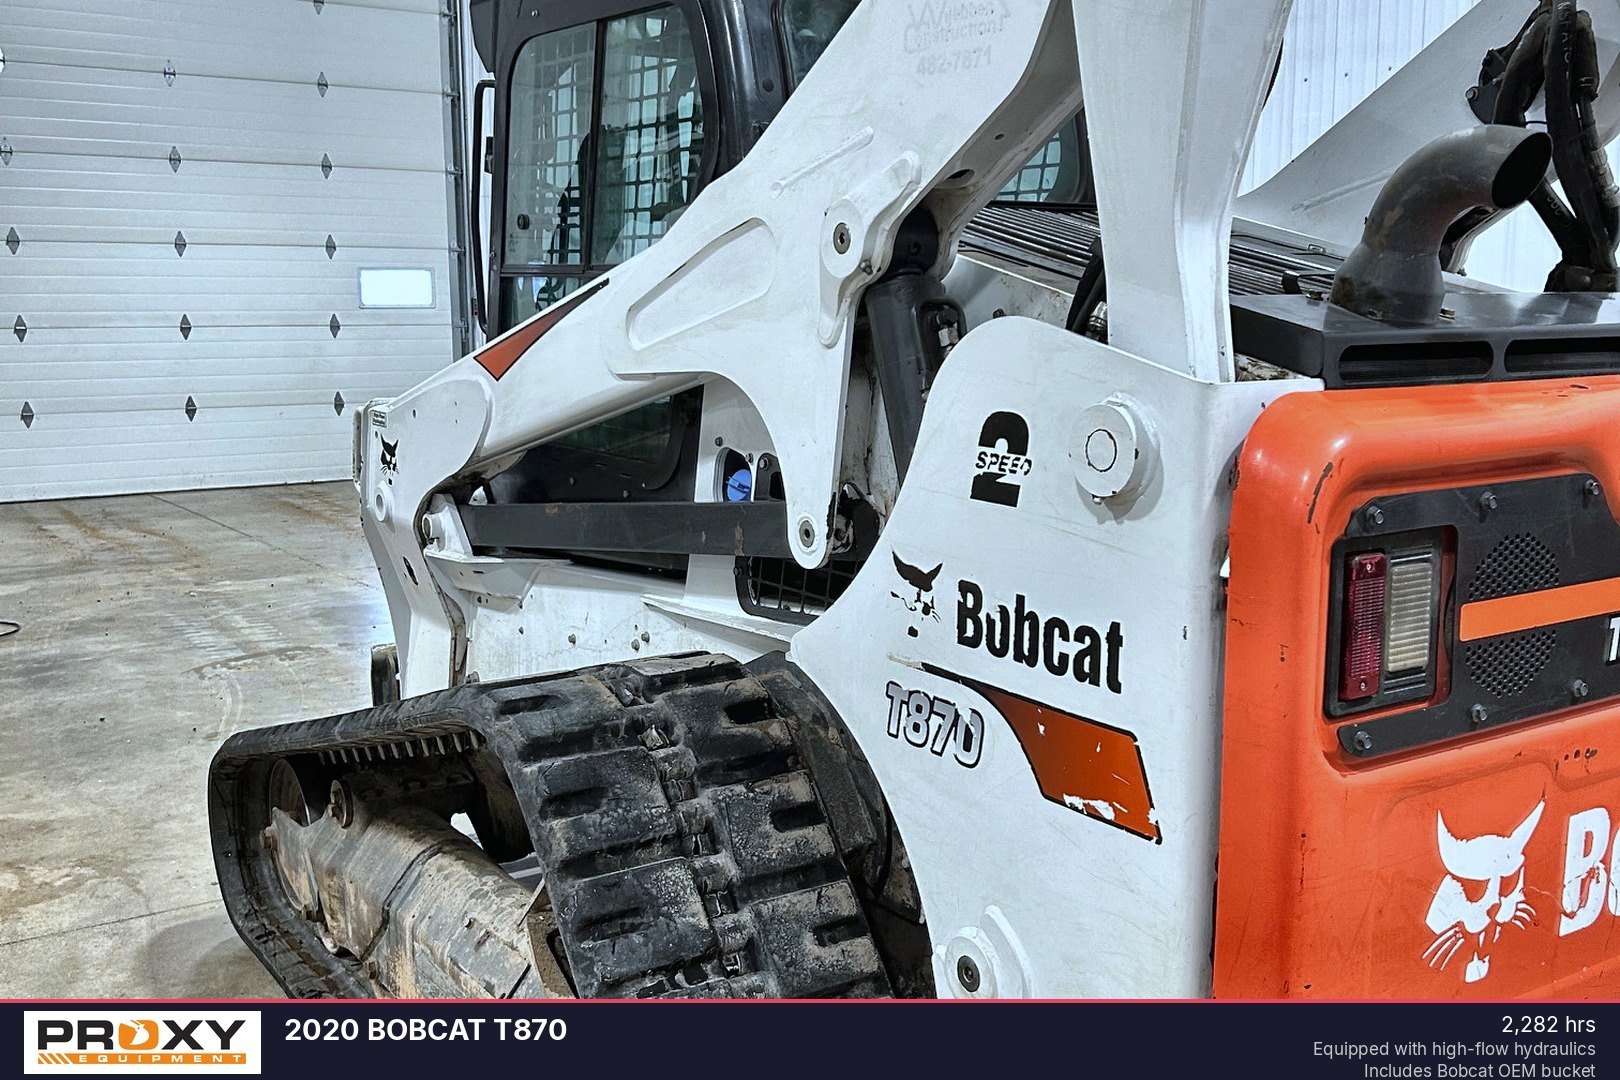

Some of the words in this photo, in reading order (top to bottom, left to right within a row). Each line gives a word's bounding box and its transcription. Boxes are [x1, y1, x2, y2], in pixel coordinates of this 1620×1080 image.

[970, 411, 1029, 508] 2
[975, 451, 1032, 476] SPEED
[957, 579, 1123, 694] Bobcat
[886, 681, 984, 769] T870
